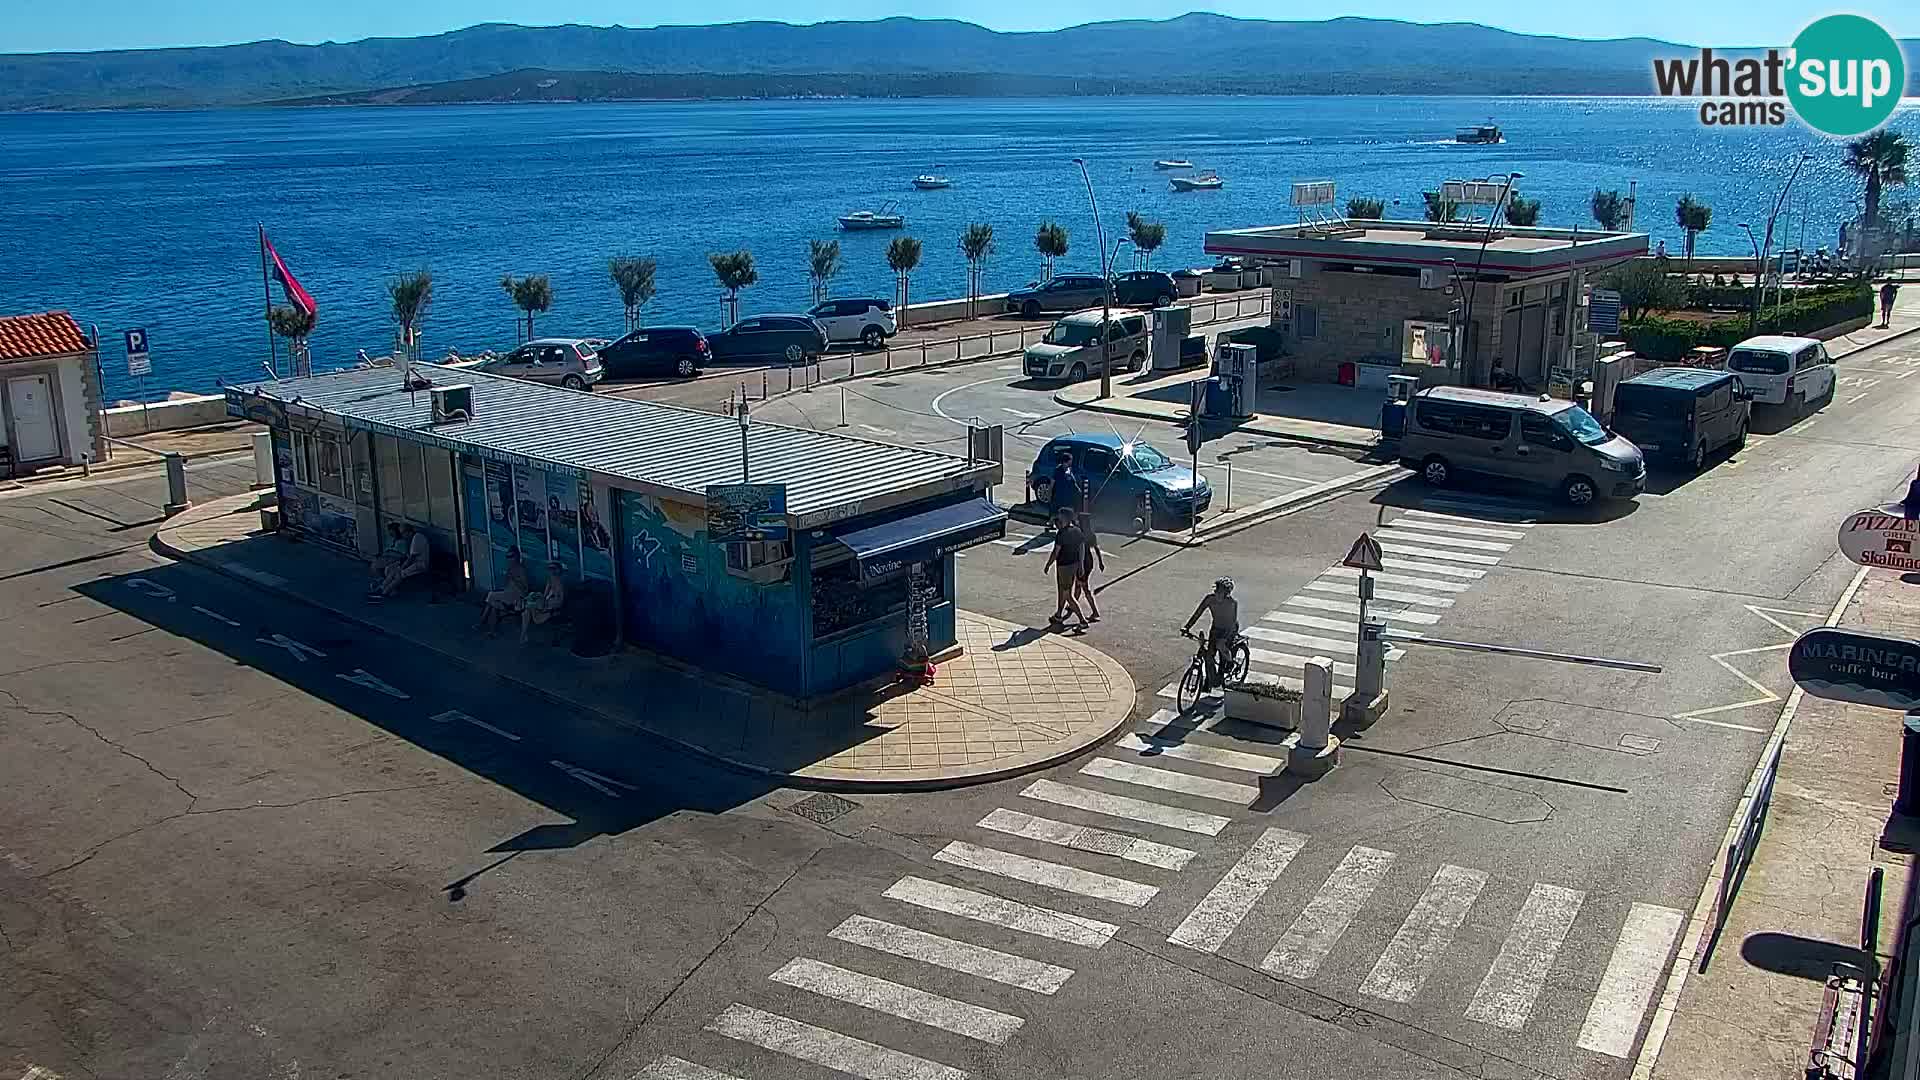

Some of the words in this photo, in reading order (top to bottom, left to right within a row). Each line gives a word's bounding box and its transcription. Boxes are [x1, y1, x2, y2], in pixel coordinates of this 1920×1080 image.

[129, 332, 142, 351] P
[479, 447, 492, 457] BUS
[494, 450, 526, 466] STATION
[529, 458, 554, 473] TICKET
[556, 463, 585, 479] OFFICE
[1848, 515, 1920, 533] PIZZE
[1883, 531, 1917, 541] GRILL
[869, 560, 902, 577] Novine
[1803, 643, 1920, 674] MARINER
[1871, 667, 1897, 681] bar
